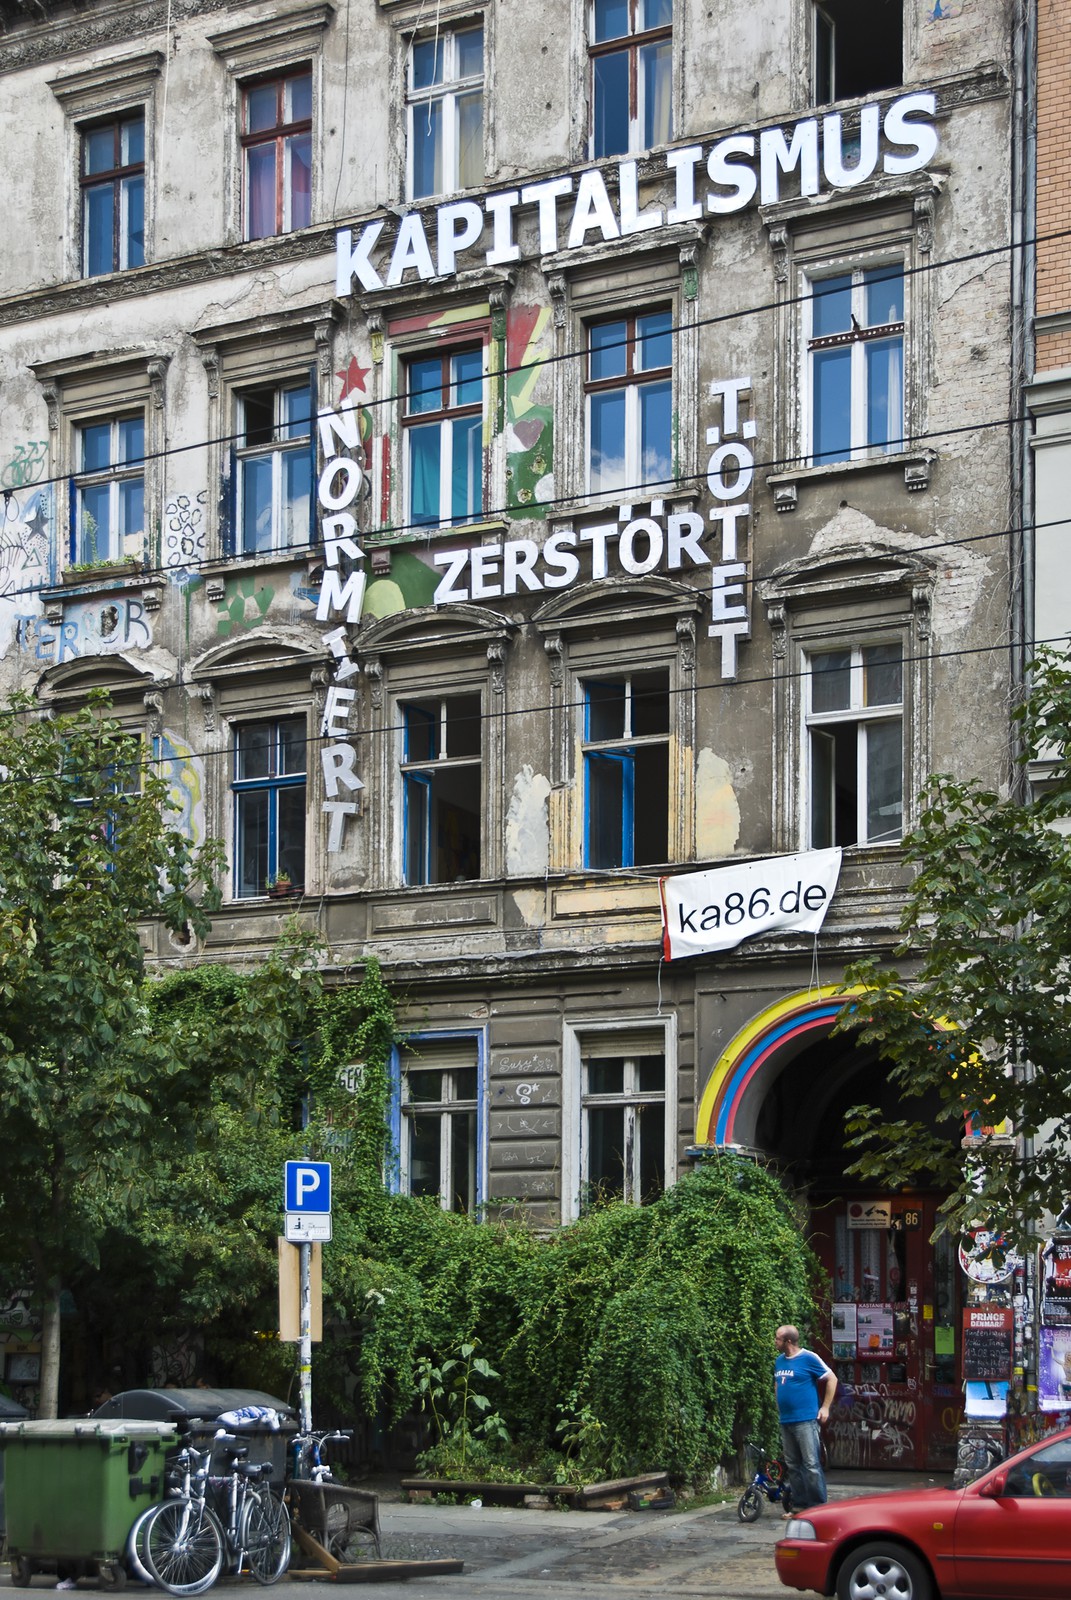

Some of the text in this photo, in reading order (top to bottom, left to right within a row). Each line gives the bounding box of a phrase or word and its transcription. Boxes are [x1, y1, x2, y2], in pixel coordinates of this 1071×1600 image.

[336, 93, 939, 298] KAPITALISMUS
[706, 377, 756, 679] TÖTET
[318, 399, 367, 853] NORMIERT
[678, 881, 827, 934] ka86.de
[296, 1168, 321, 1206] P
[905, 1212, 918, 1225] 86
[970, 1312, 1005, 1321] PRINCE
